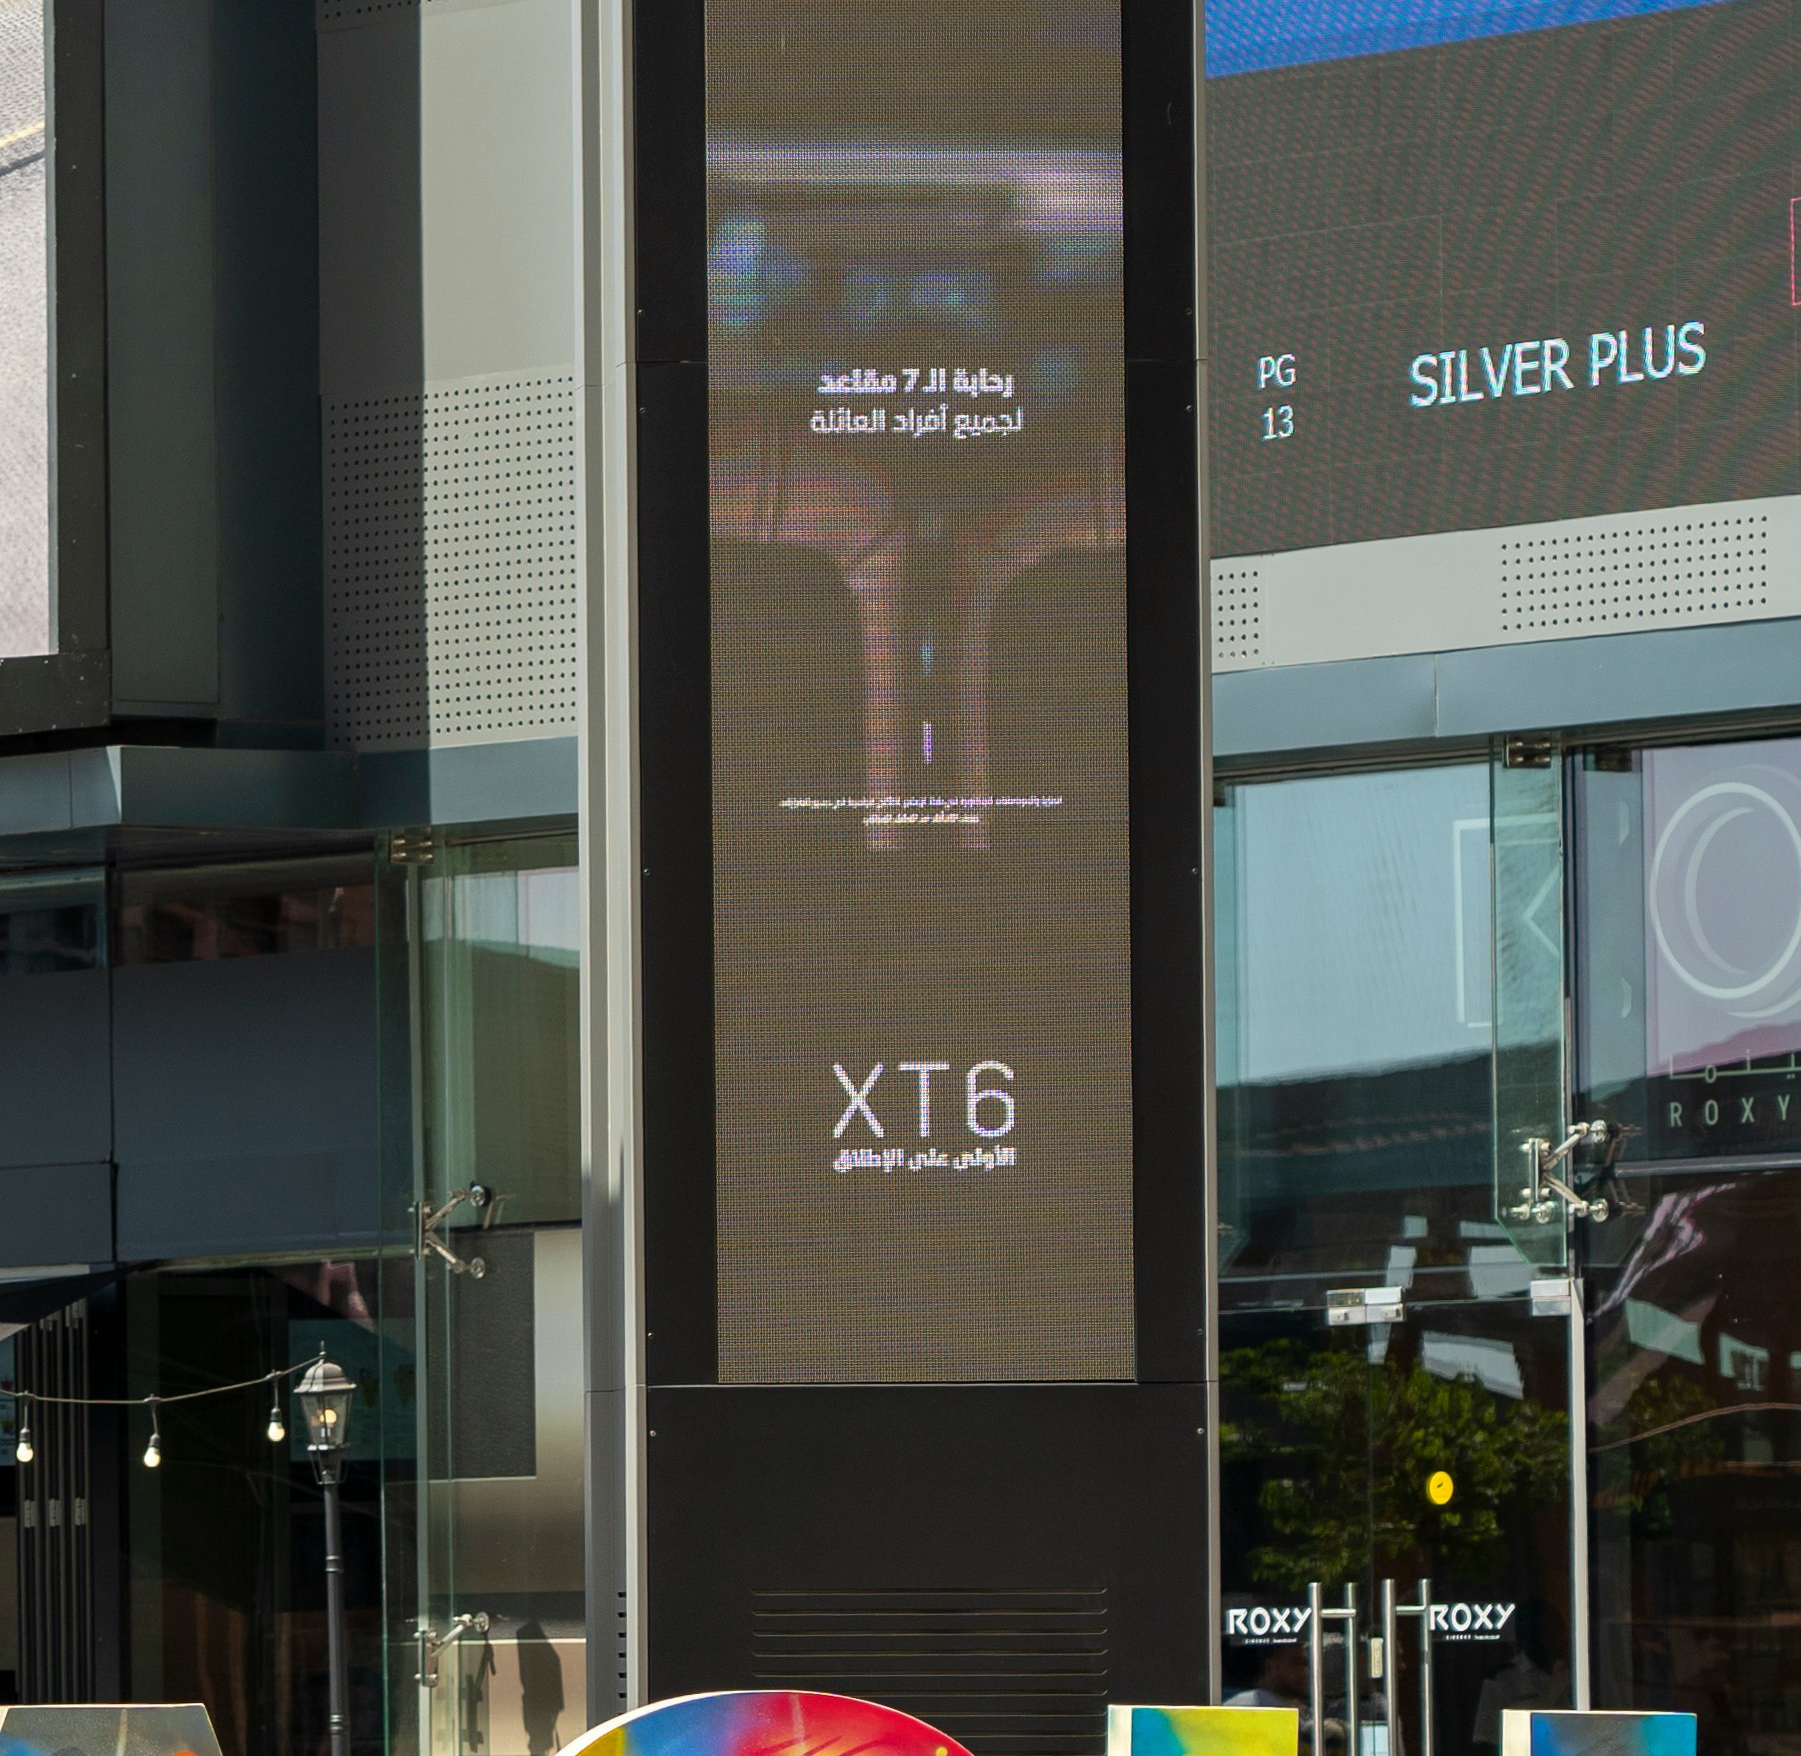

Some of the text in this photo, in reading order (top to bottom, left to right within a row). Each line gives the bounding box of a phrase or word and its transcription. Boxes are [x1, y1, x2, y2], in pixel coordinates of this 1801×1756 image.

[817, 367, 898, 395] مقاعد
[1257, 353, 1296, 390] PG
[1409, 321, 1707, 407] SILVER PLUS
[952, 367, 1015, 399] رحابة
[809, 402, 1024, 440] لجميع أفراد العائلة
[1261, 404, 1296, 441] 13
[832, 1060, 1015, 1138] XT6
[1669, 1094, 1791, 1128] ROXY
[907, 1148, 950, 1173] على
[1228, 1607, 1312, 1636] ROXY
[1429, 1602, 1516, 1631] ROXY
